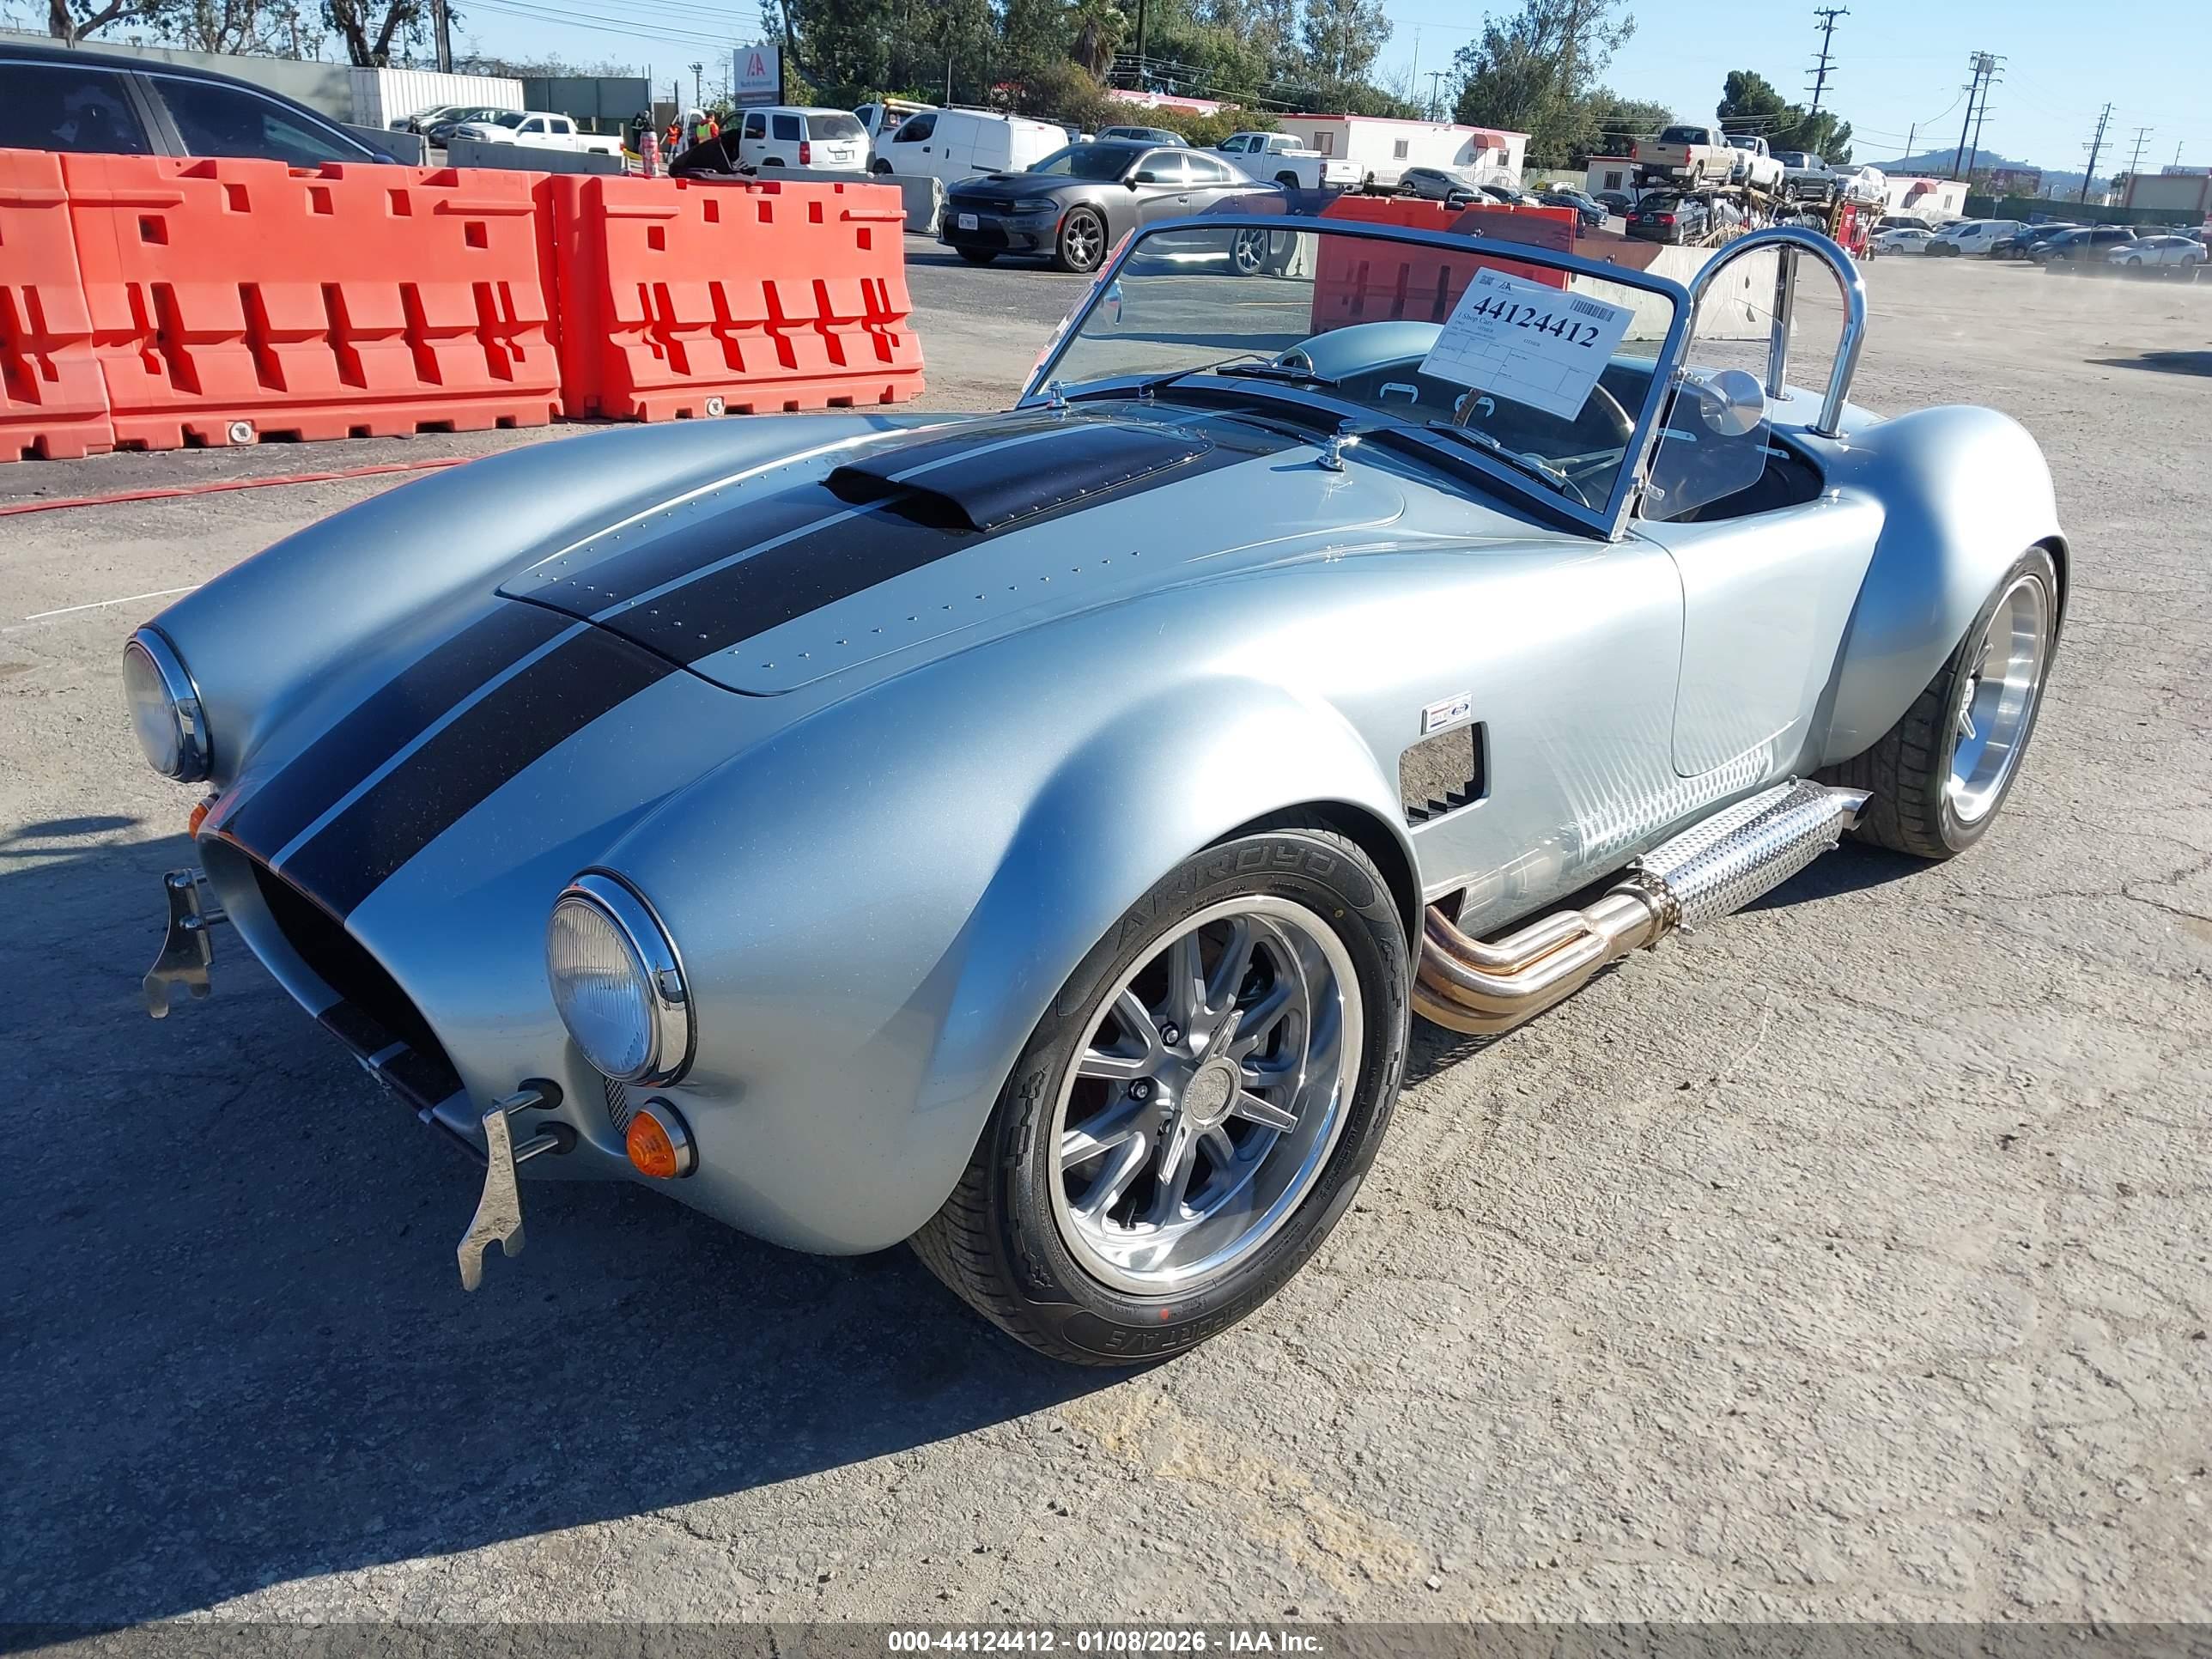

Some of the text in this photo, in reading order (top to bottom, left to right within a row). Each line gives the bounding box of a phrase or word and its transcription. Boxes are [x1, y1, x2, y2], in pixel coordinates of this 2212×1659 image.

[1462, 313, 1479, 324] Shop
[1479, 317, 1494, 326] Cars
[1472, 295, 1600, 349] 44124412
[1116, 844, 1337, 951] ARROYO
